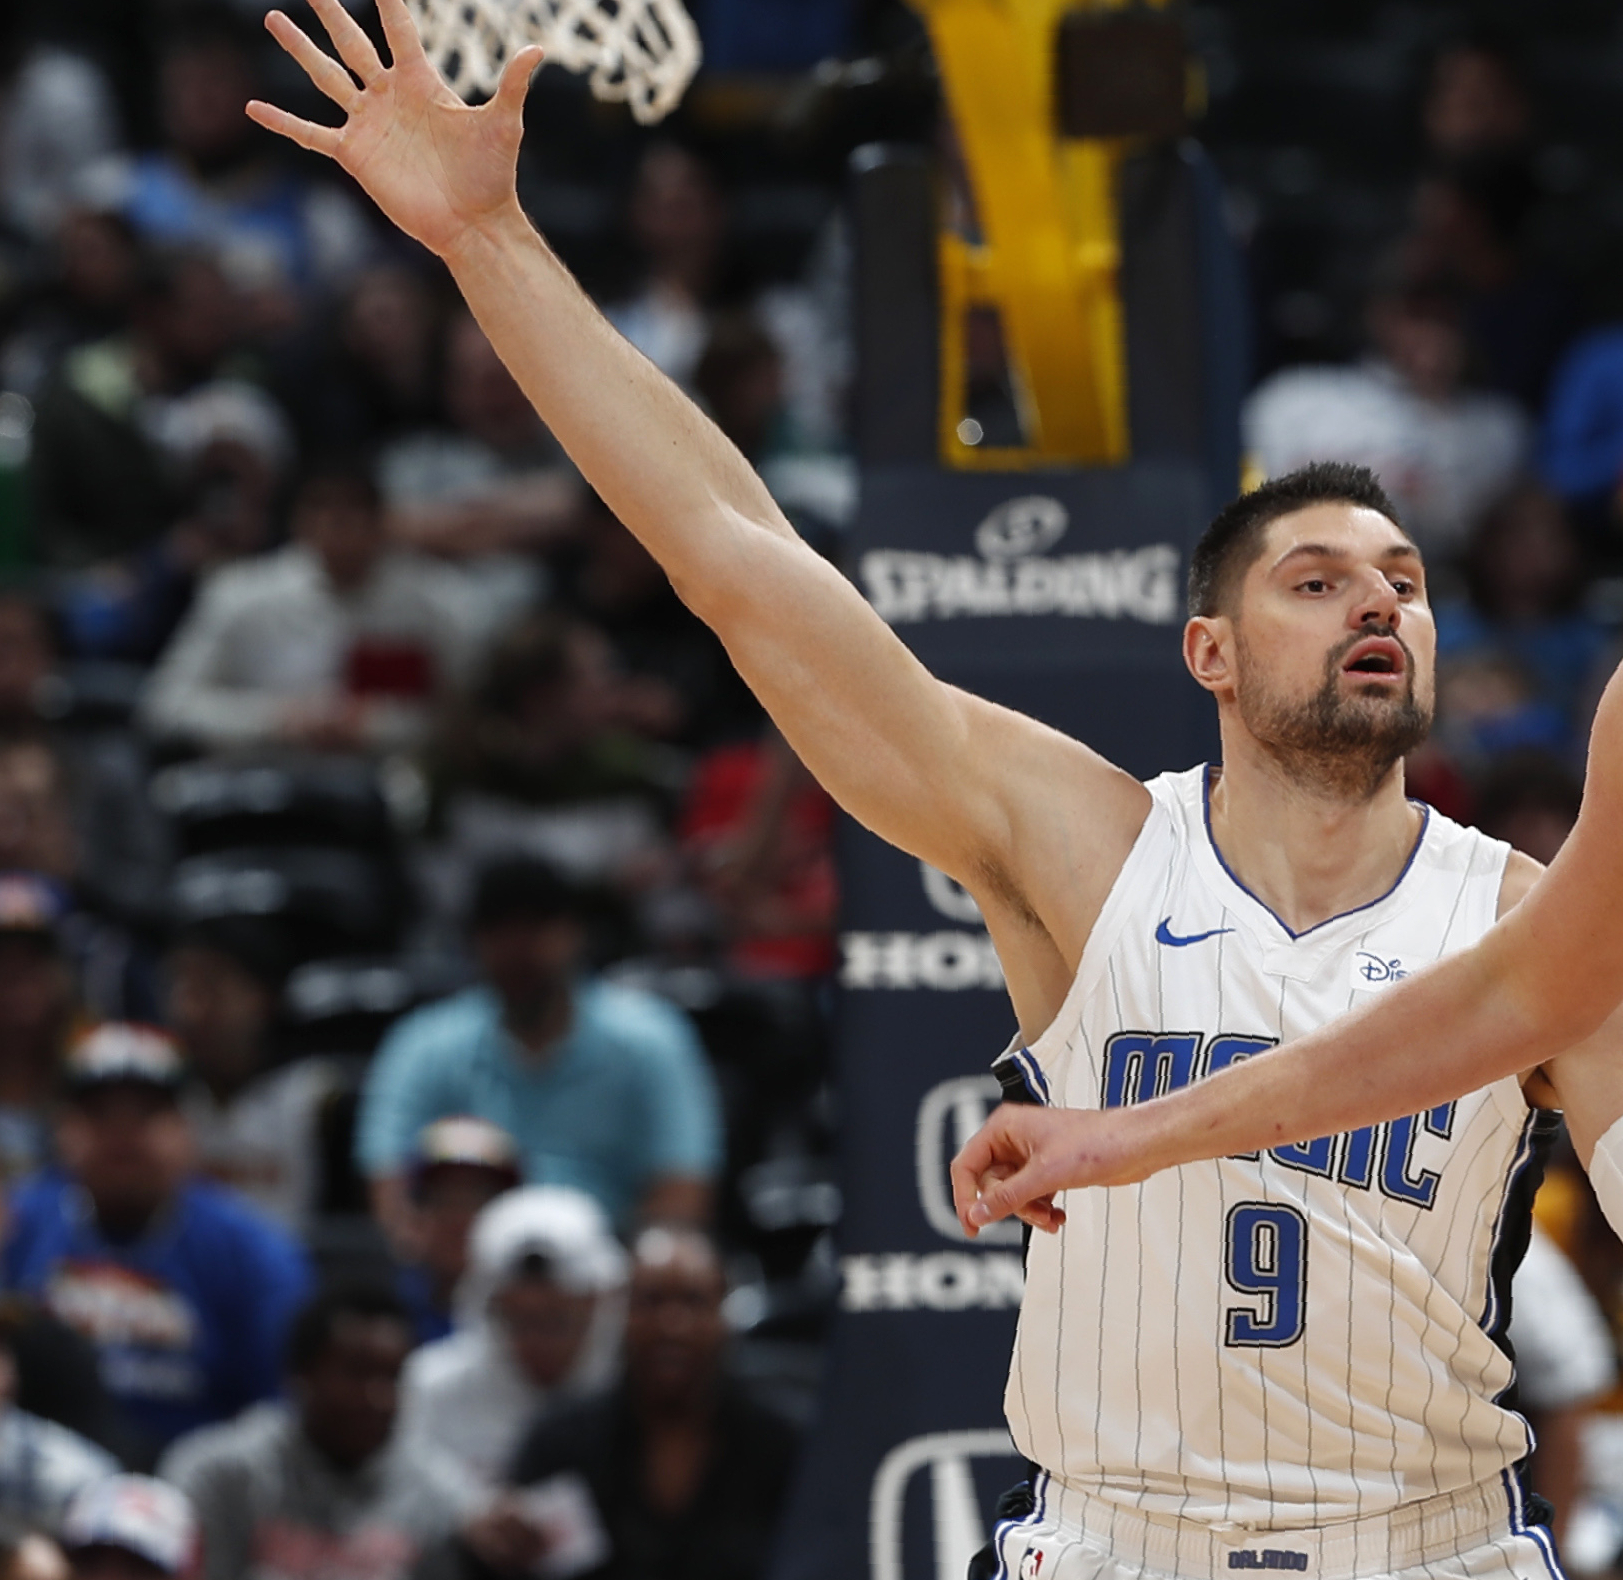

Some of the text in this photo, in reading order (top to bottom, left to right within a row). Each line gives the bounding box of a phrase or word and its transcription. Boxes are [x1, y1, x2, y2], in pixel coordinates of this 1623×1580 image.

[1355, 951, 1413, 982] Dis
[1224, 1200, 1307, 1349] 9
[1228, 1549, 1309, 1572] ORLANDO
